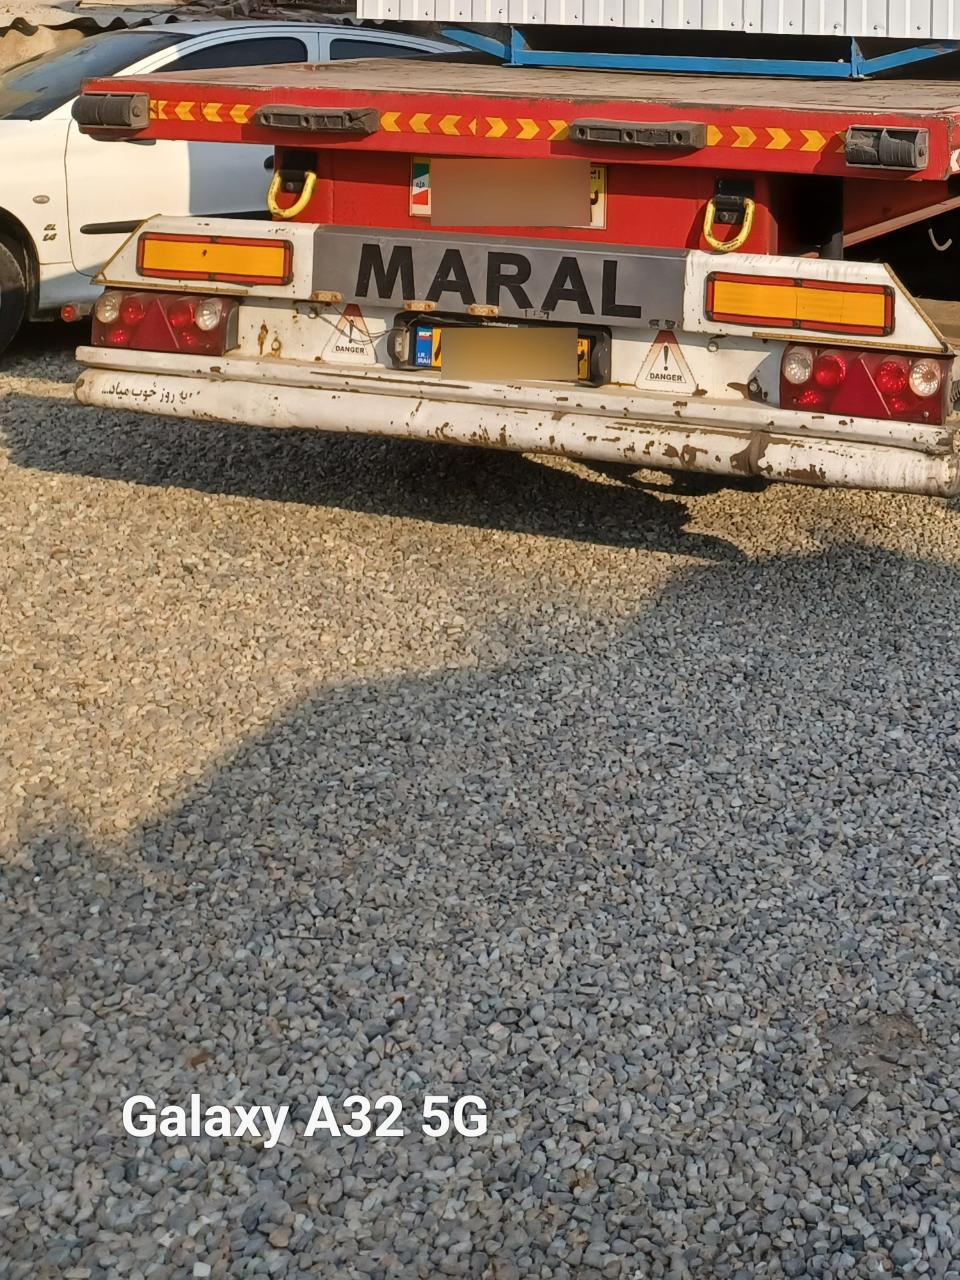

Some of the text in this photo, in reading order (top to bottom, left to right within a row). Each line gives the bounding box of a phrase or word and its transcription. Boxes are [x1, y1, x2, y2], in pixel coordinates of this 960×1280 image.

[355, 243, 642, 319] MARAL
[335, 345, 366, 354] DANGER
[649, 372, 683, 382] DANGER
